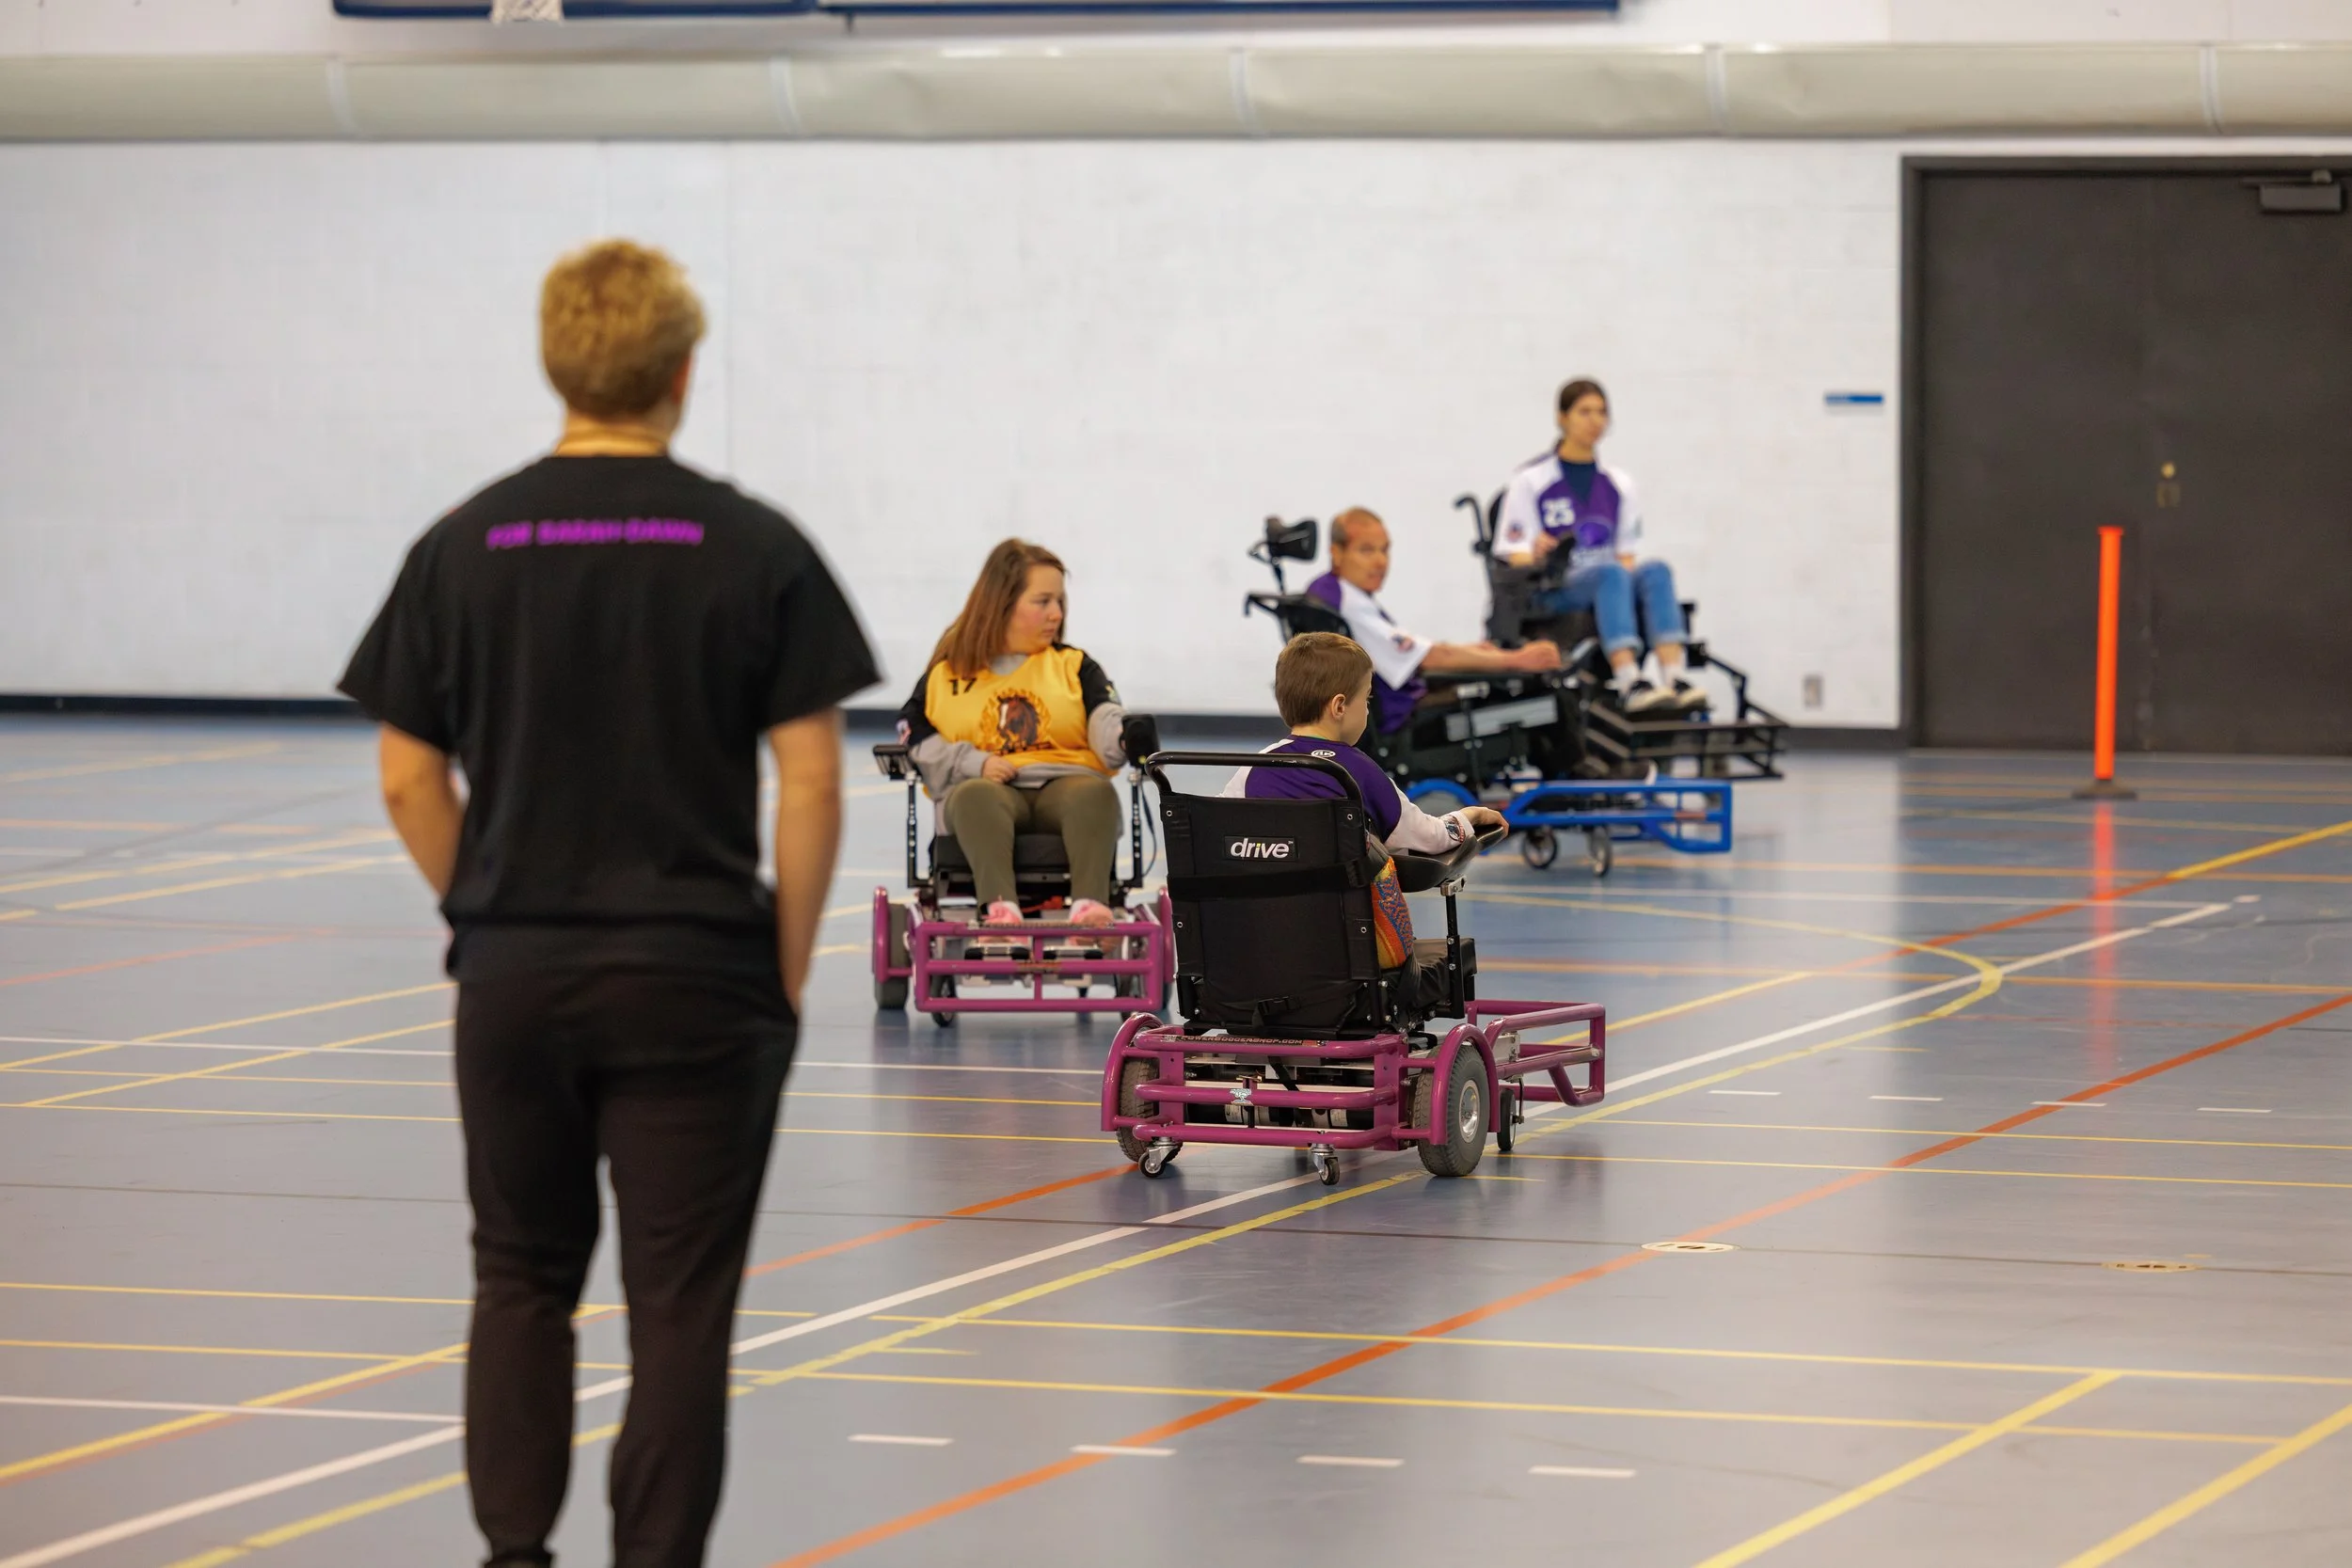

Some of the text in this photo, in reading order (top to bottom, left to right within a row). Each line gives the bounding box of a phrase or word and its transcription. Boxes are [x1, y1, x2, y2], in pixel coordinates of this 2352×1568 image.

[1543, 497, 1575, 528] 25
[948, 677, 977, 695] 17
[1231, 837, 1290, 859] drive
